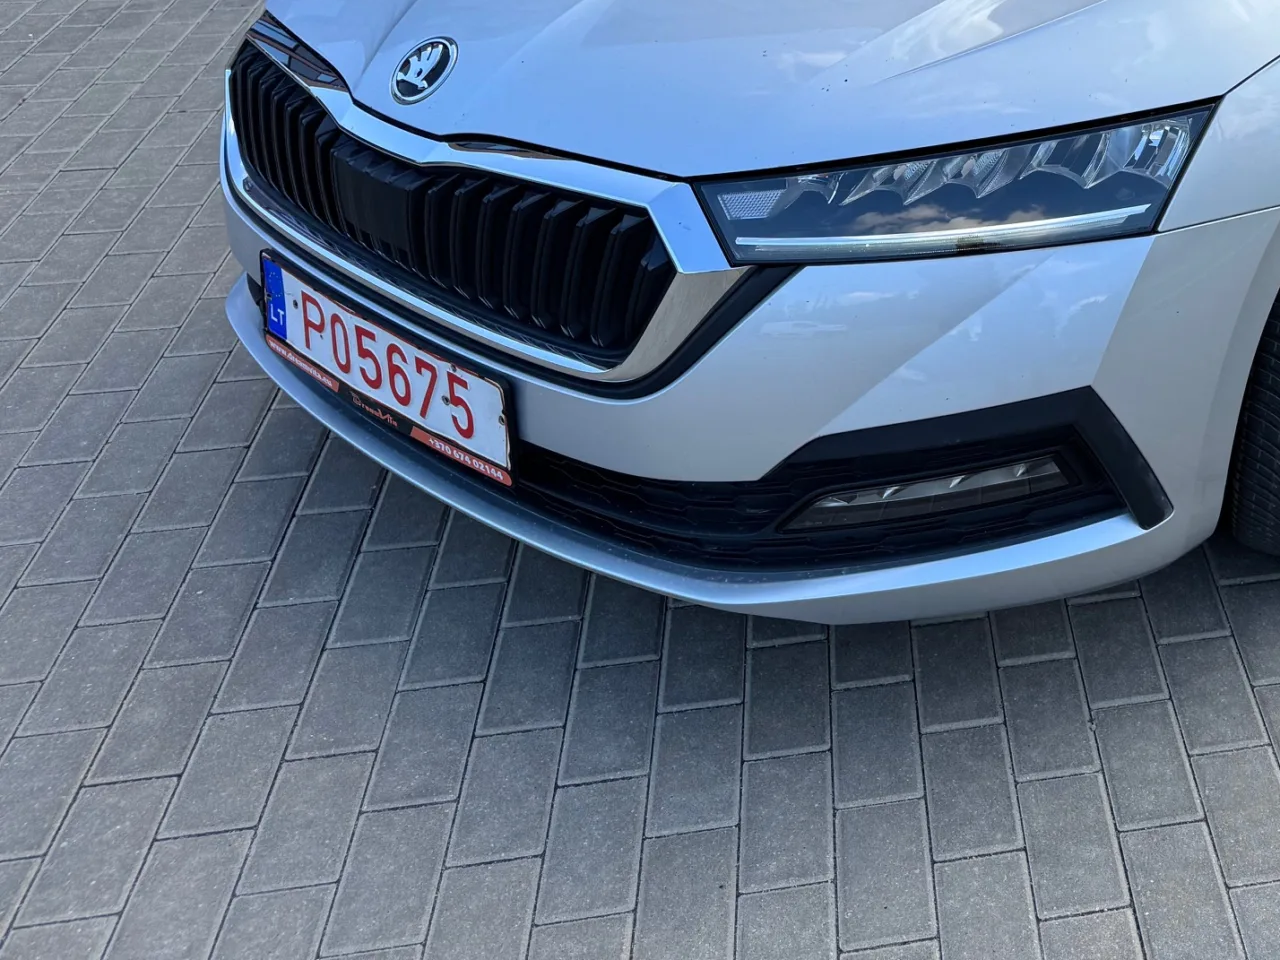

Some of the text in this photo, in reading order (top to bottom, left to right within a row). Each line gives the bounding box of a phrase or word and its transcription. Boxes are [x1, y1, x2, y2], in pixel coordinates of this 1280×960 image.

[270, 308, 286, 326] LT
[301, 289, 475, 440] P05675
[429, 438, 504, 480] +370 674 02144
